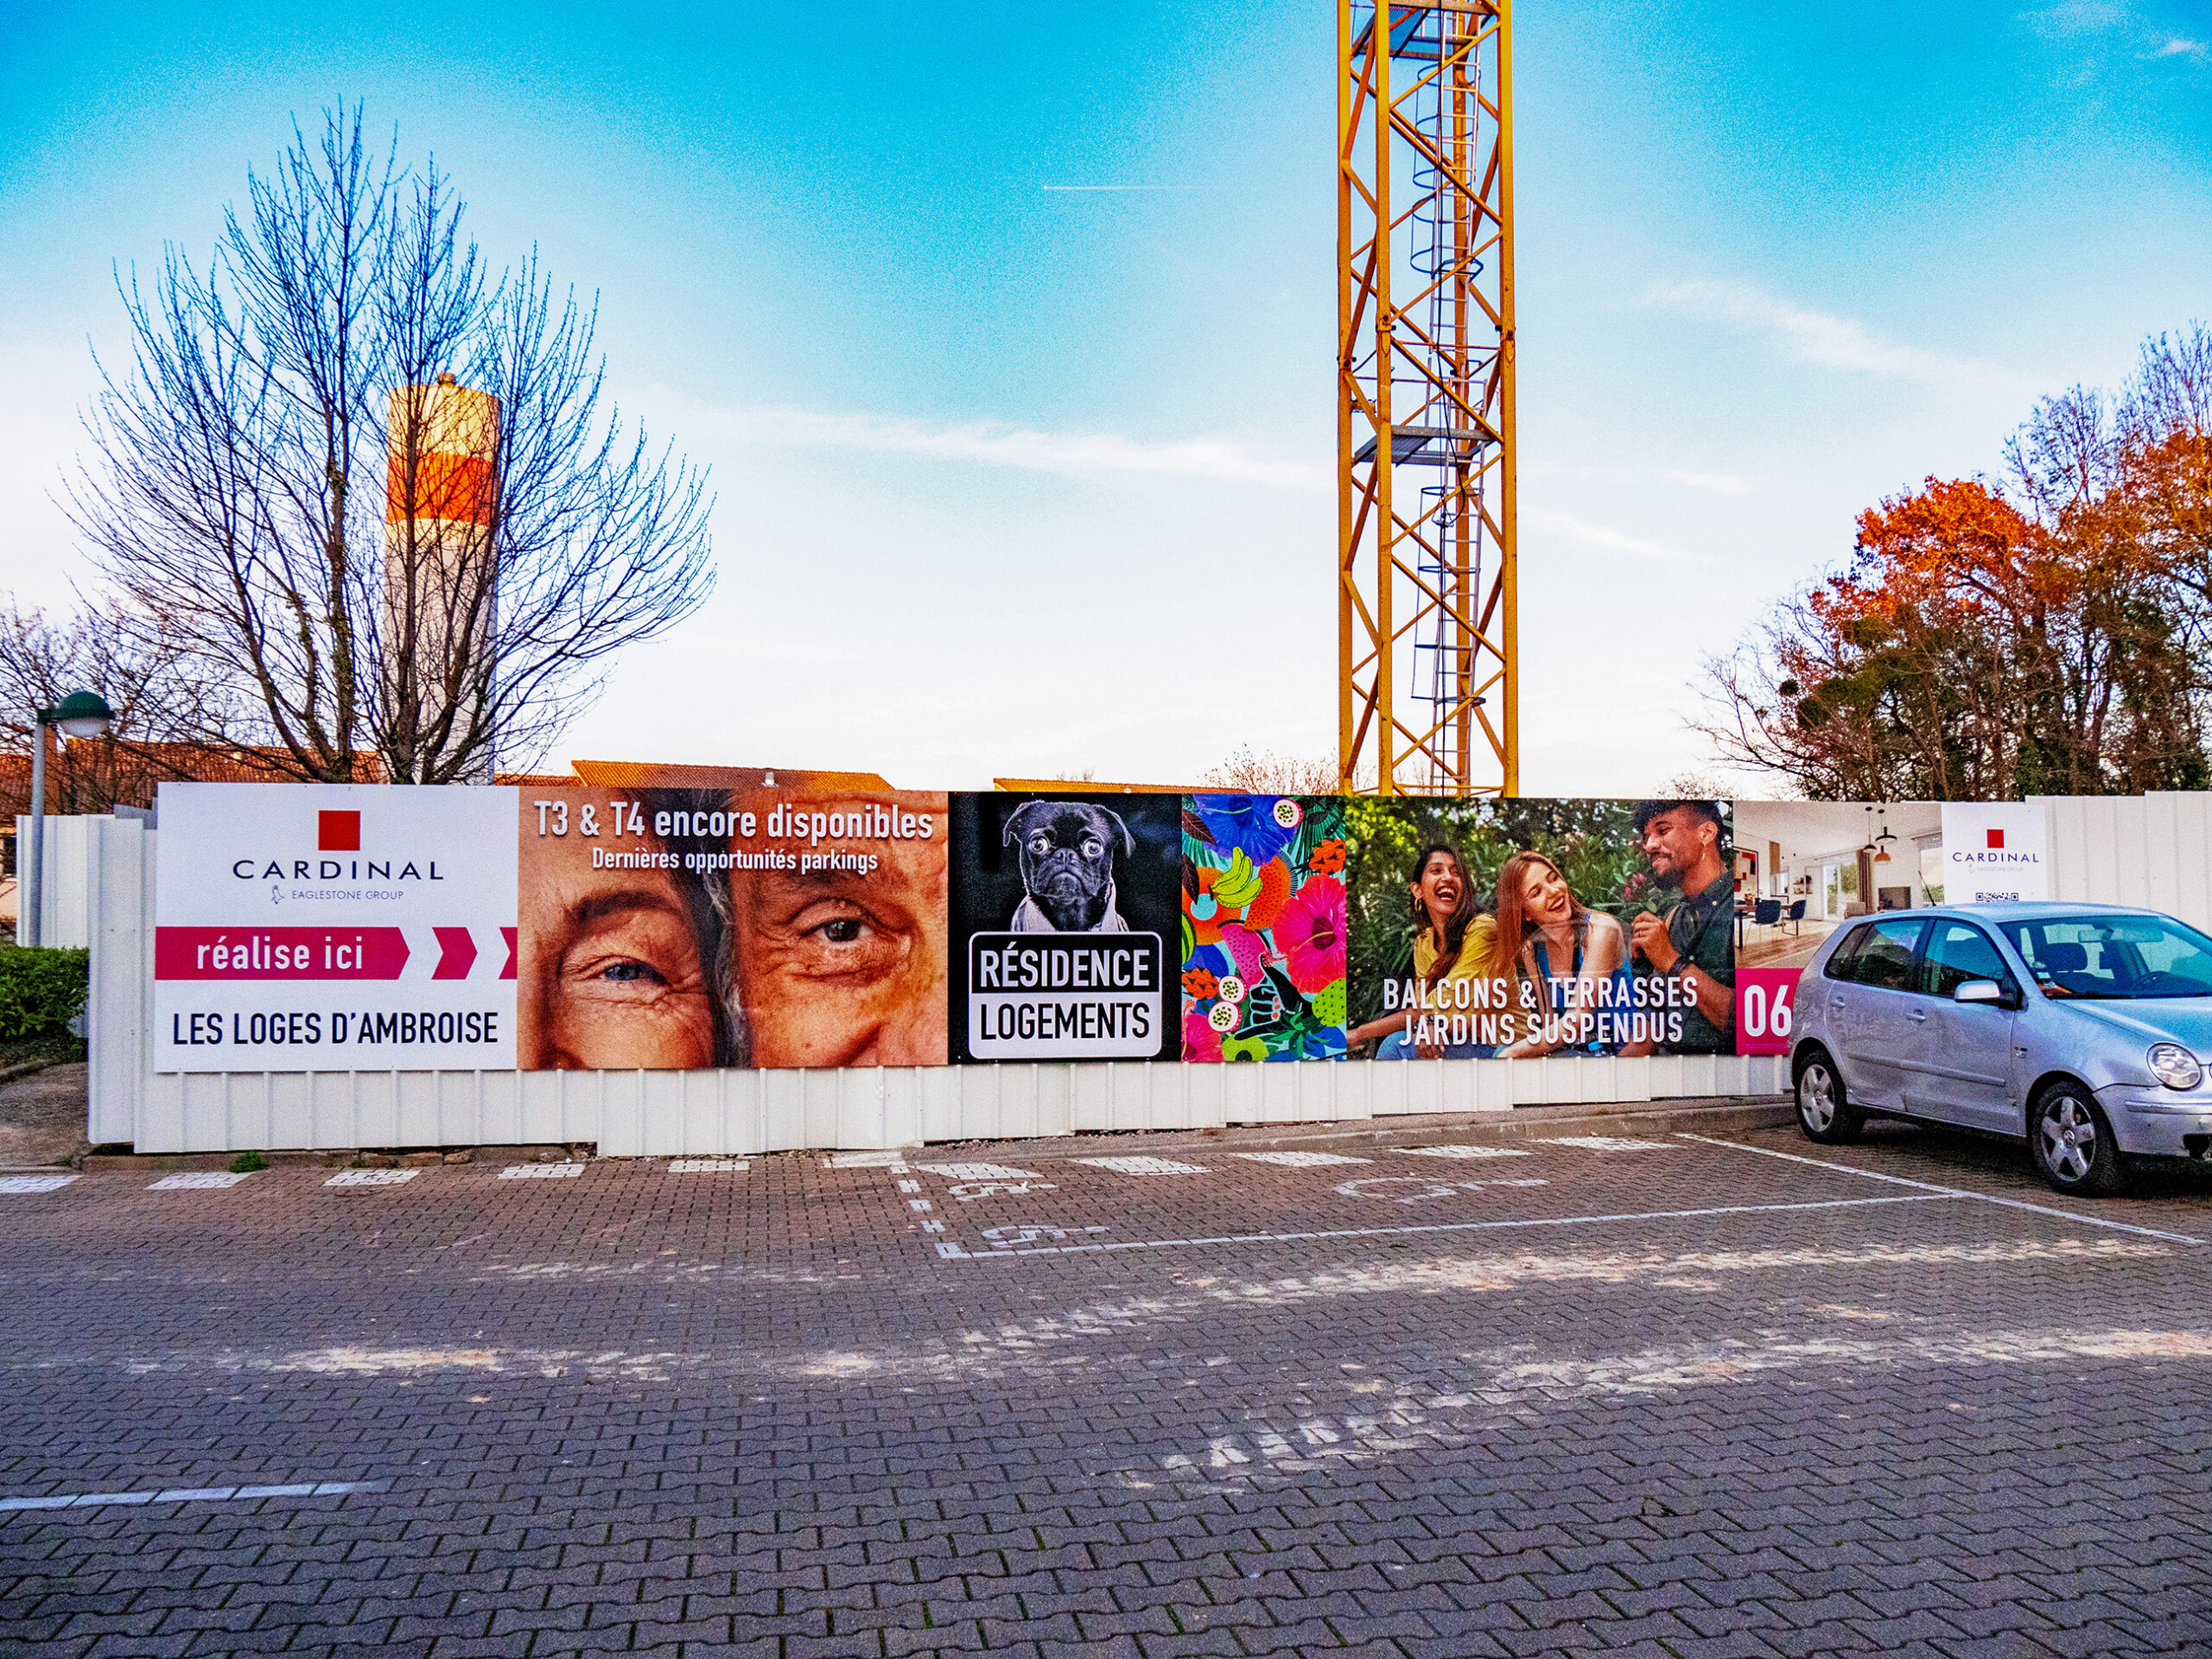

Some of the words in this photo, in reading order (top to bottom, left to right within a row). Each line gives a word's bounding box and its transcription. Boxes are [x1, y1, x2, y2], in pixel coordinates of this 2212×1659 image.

[534, 800, 569, 836] T3
[579, 804, 601, 836] &
[610, 801, 645, 836] T4
[655, 810, 757, 838] encore
[767, 803, 933, 847] disponibles
[232, 859, 444, 880] CARDINAL
[592, 846, 680, 869] Dernières
[684, 848, 797, 874] opportunités
[801, 849, 879, 875] parkings
[1952, 852, 2039, 862] CARDINAL
[292, 890, 361, 899] EAGLESTONE
[365, 890, 404, 900] GROUP
[197, 935, 310, 969] réalise
[325, 936, 363, 969] ici
[980, 941, 1150, 988] RÉSIDENCE
[1383, 977, 1508, 1010] BALCONS
[1519, 980, 1537, 1009] &
[1548, 976, 1698, 1008] TERRASSES
[981, 1001, 1150, 1040] LOGEMENTS
[1744, 984, 1792, 1037] 06
[173, 1013, 224, 1045] LES
[233, 1012, 321, 1045] LOGES
[1399, 1013, 1515, 1046] JARDINS
[1527, 1011, 1683, 1044] SUSPENDUS
